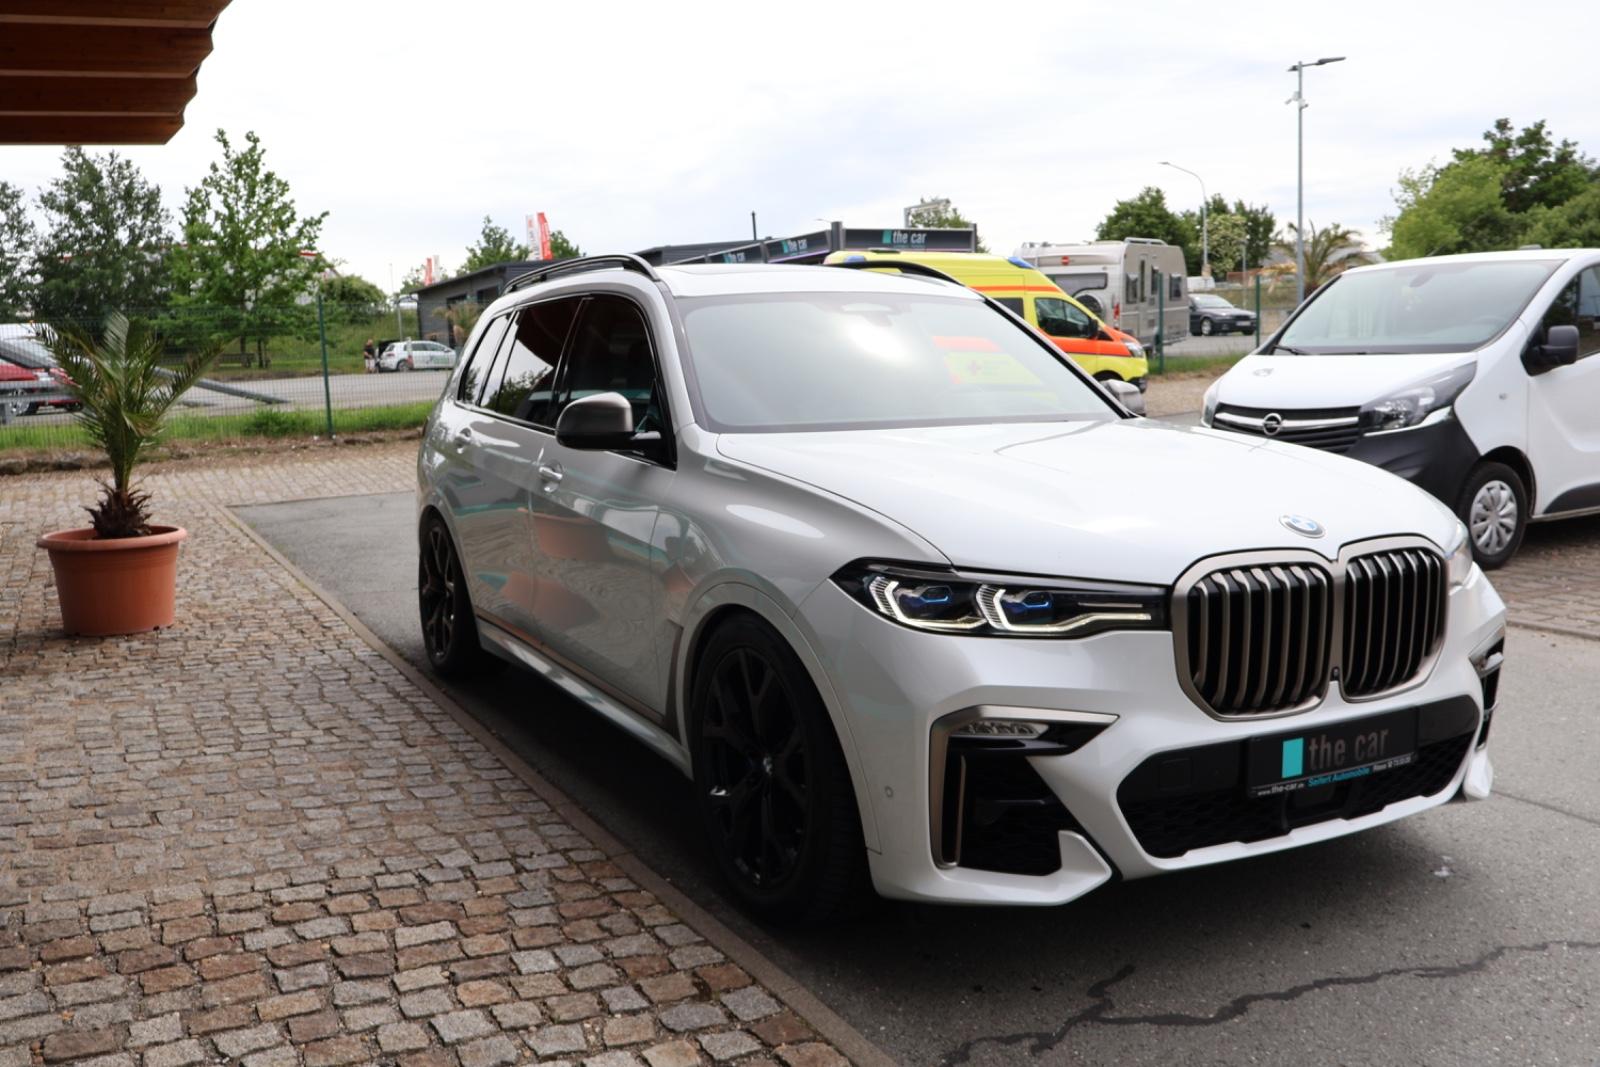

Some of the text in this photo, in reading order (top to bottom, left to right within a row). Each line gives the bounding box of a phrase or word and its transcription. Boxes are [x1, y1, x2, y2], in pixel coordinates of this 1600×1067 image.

[892, 230, 927, 244] the car
[1308, 735, 1346, 770] the
[1354, 728, 1390, 760] car
